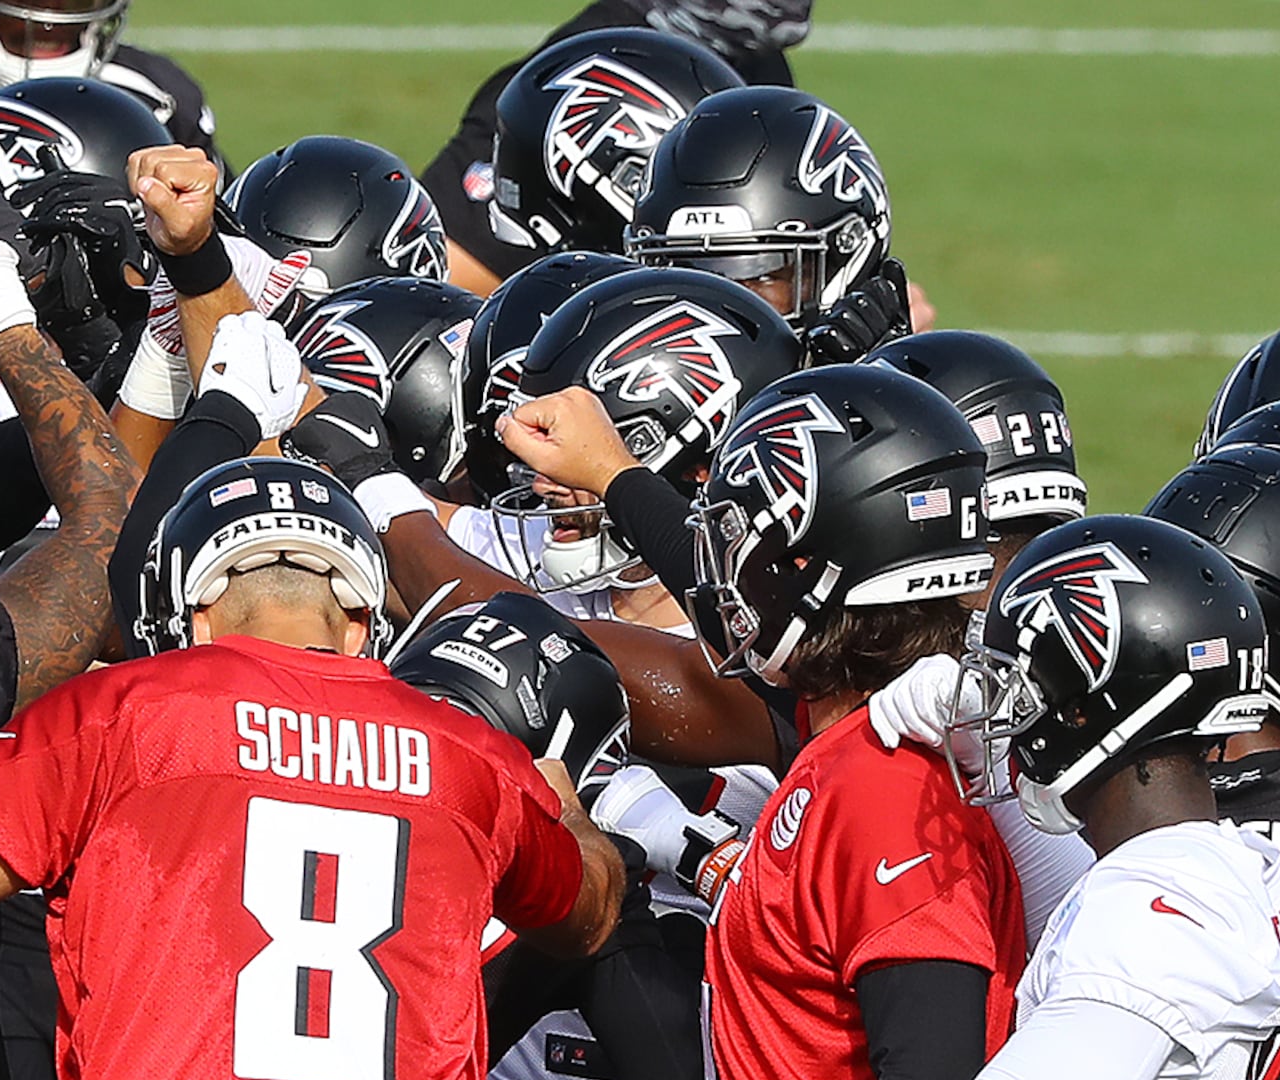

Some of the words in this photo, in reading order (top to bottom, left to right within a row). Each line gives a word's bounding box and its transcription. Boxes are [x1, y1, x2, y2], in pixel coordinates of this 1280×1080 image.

[684, 210, 726, 226] ATL
[1006, 411, 1065, 457] 22
[268, 482, 296, 511] 8
[213, 516, 358, 552] FALCONS
[961, 497, 976, 540] 6
[462, 615, 528, 652] 27
[1237, 648, 1263, 691] 18
[234, 700, 431, 798] SCHAUB
